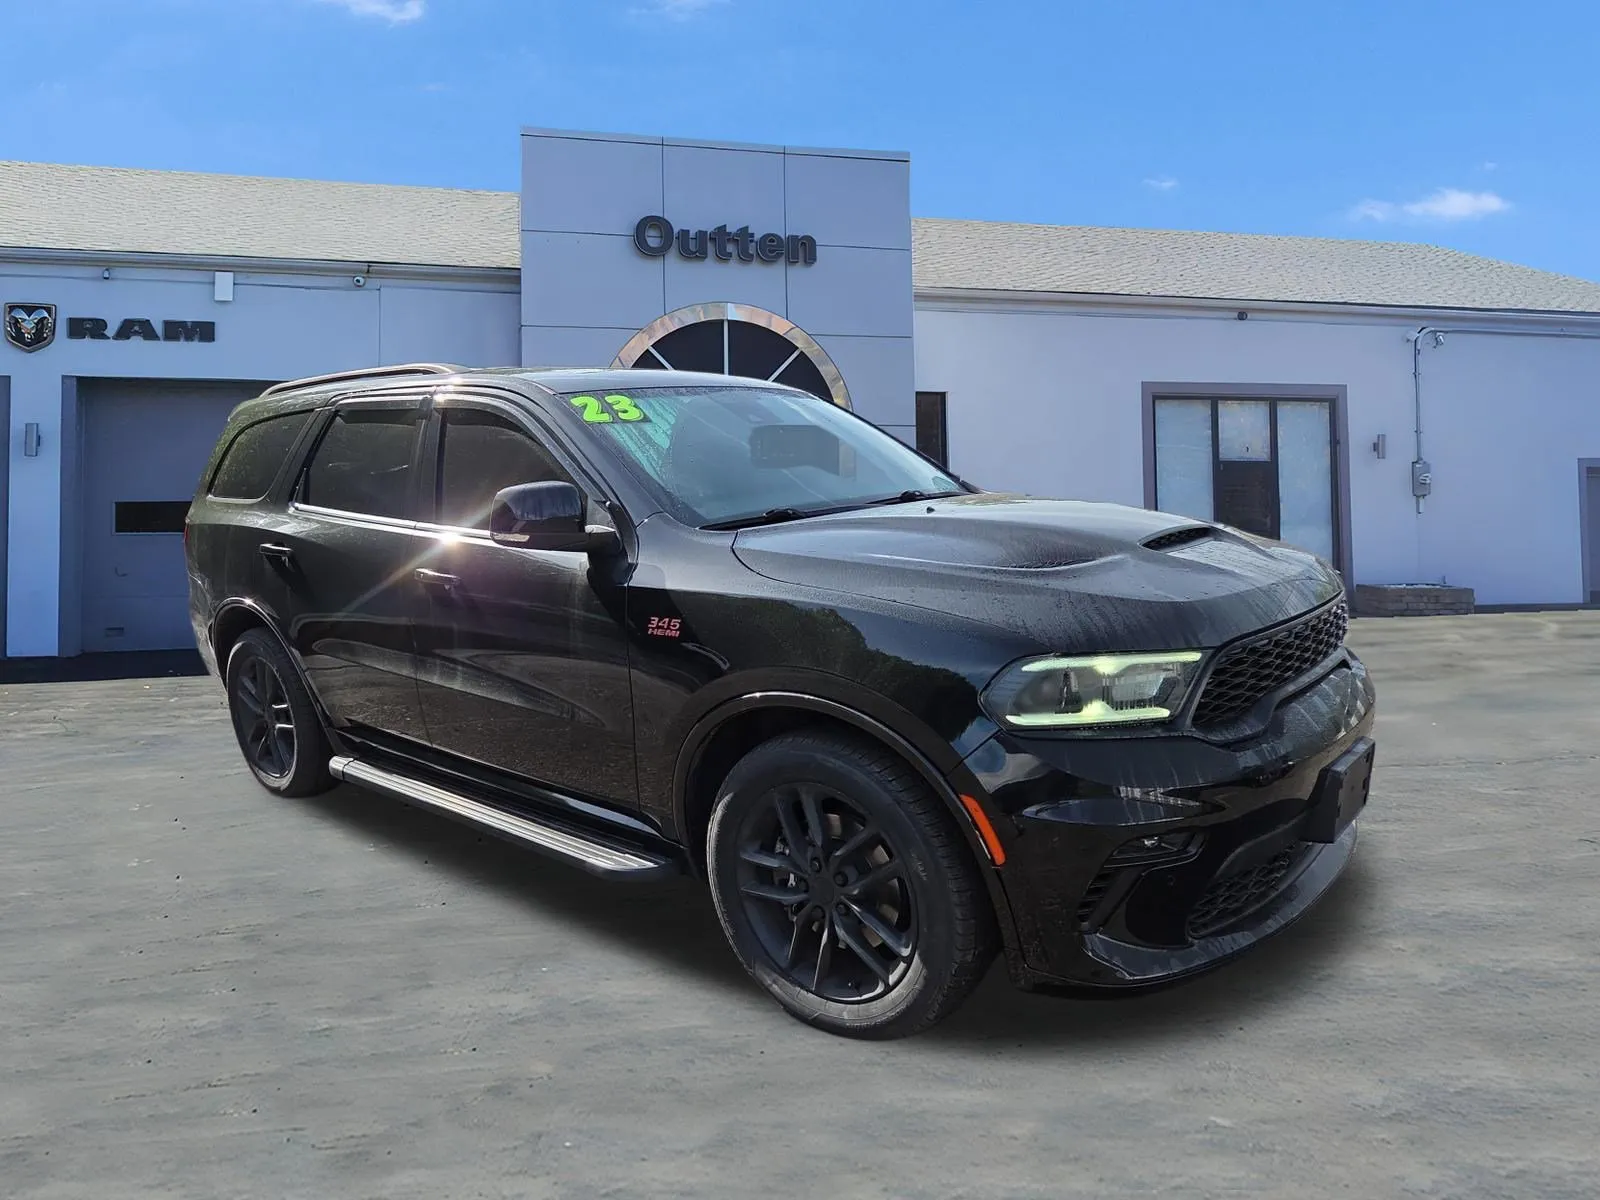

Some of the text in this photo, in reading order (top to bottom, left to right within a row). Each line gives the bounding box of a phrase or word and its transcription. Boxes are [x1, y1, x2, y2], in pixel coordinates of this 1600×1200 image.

[634, 215, 817, 264] Outten
[67, 317, 215, 342] RAM
[570, 394, 644, 422] 23
[648, 616, 681, 630] 345
[648, 628, 680, 637] HEMI
